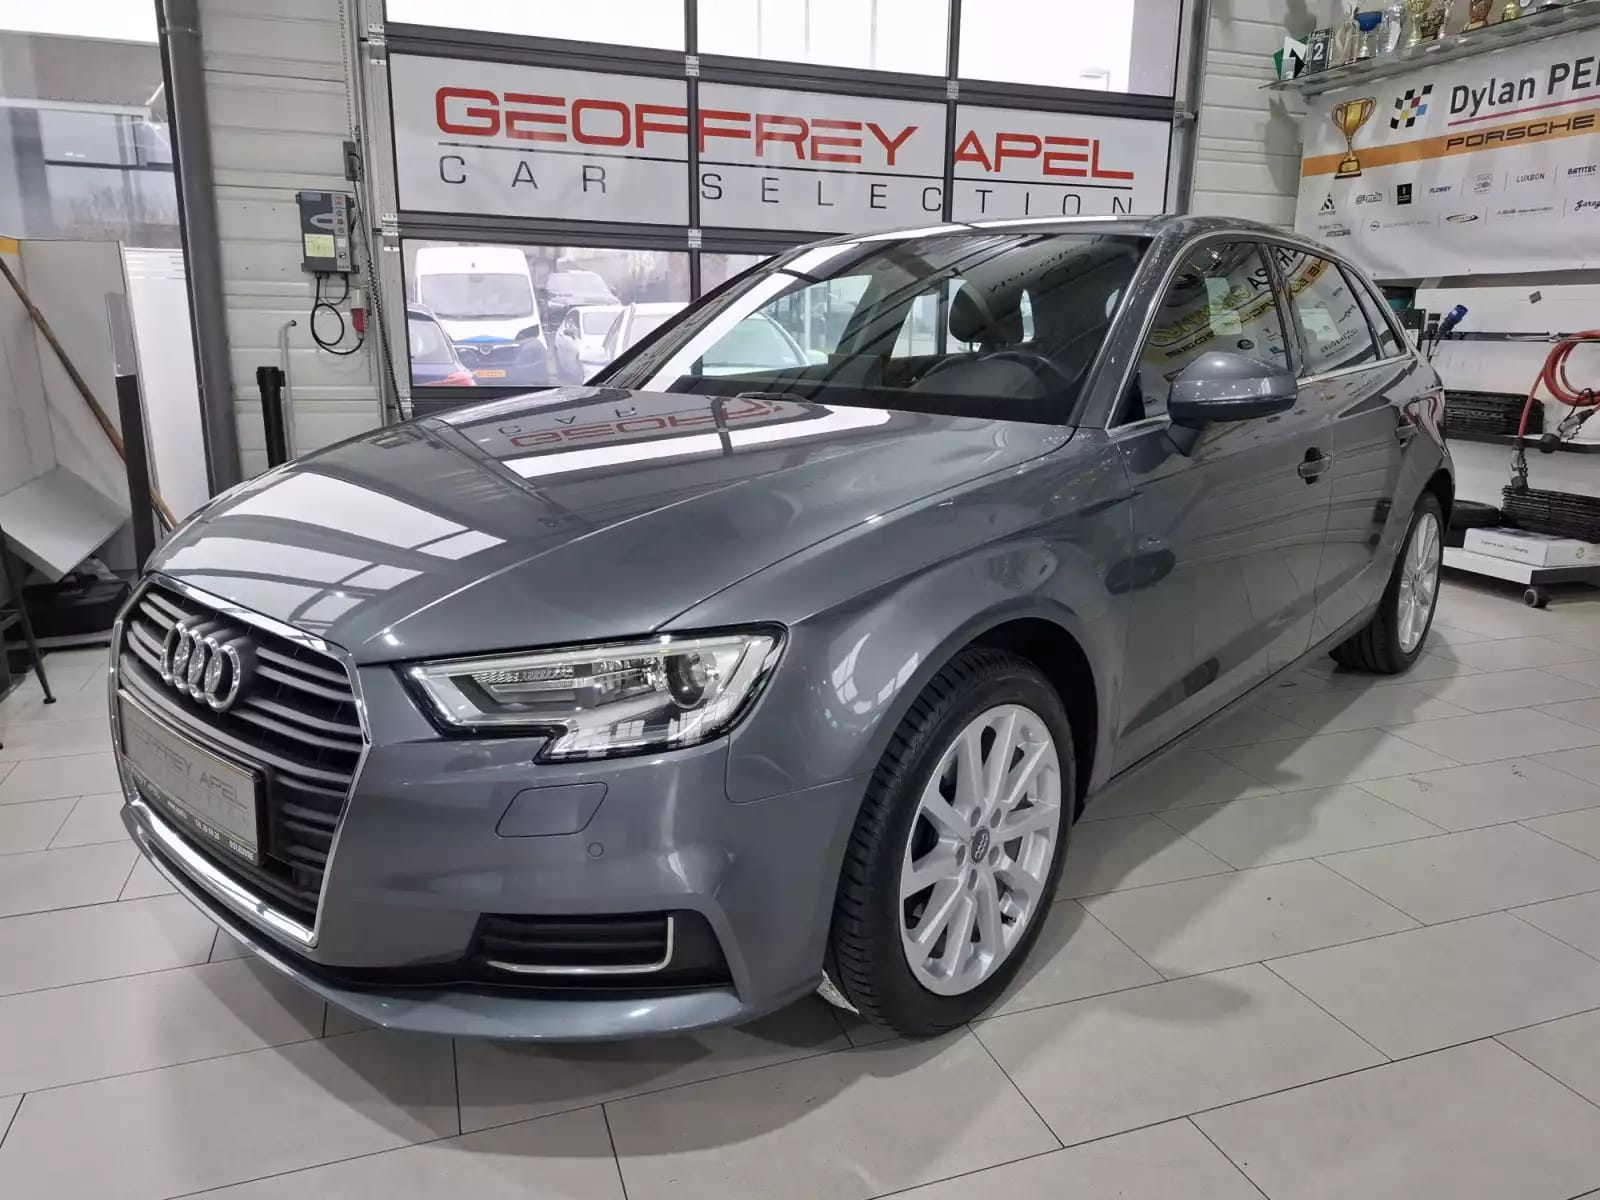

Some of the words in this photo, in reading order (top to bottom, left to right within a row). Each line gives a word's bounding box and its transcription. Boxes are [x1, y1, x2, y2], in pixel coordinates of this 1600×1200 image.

[1450, 77, 1536, 118] Dylan
[1547, 56, 1600, 95] PE
[435, 86, 919, 166] GEOFFREY
[953, 130, 1134, 180] APEL
[1446, 114, 1596, 151] PORSCHE
[439, 155, 607, 193] CAR
[700, 173, 1133, 215] SELECTION
[200, 771, 249, 810] APEL
